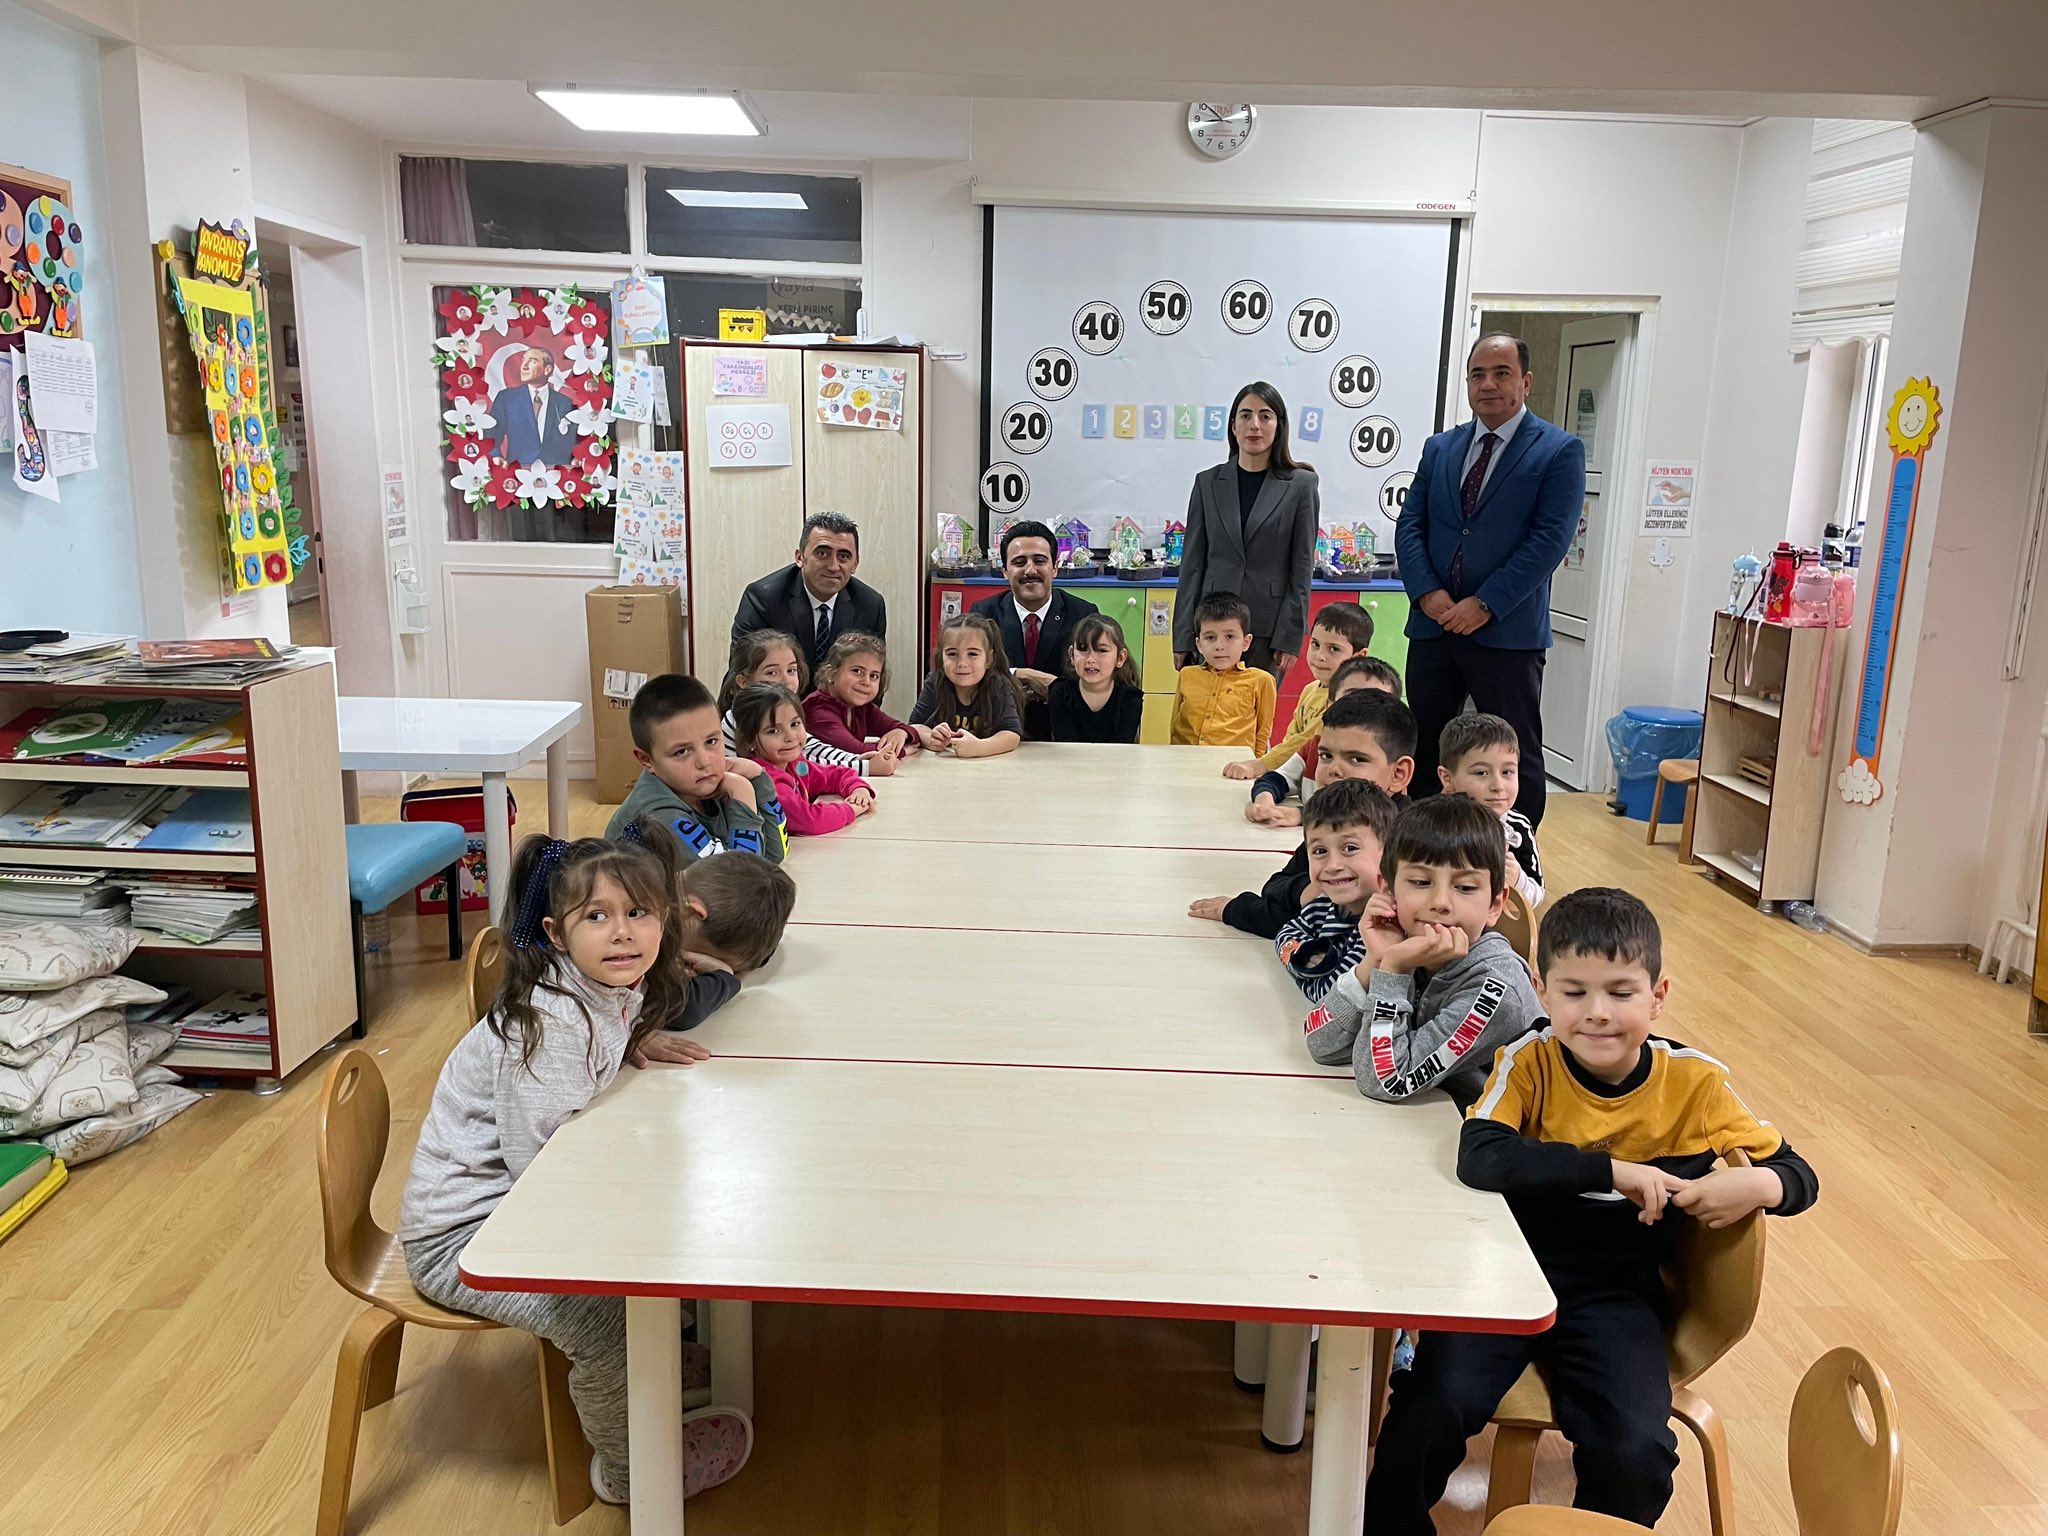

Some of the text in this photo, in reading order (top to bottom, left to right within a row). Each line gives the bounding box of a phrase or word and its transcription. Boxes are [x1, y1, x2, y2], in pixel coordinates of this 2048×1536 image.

[1217, 141, 1224, 149] 6
[196, 251, 243, 282] PANOMUZ
[803, 302, 834, 317] PİRİNÇ
[1147, 292, 1186, 321] 50
[1229, 291, 1267, 320] 60
[1079, 313, 1120, 341] 40
[1298, 310, 1333, 338] 70
[1034, 358, 1072, 387] 30
[1338, 366, 1375, 394] 80
[1009, 412, 1047, 440] 20
[1088, 409, 1099, 429] 1
[1120, 409, 1132, 429] 2
[1151, 409, 1162, 429] 3
[1178, 409, 1192, 430] 4
[1210, 410, 1223, 431] 5
[1305, 411, 1317, 432] 8
[1357, 426, 1395, 453] 90
[986, 474, 1023, 502] 10
[1484, 978, 1506, 997] IS
[1473, 993, 1499, 1017] NO
[1447, 1013, 1487, 1056] LIMITS
[1406, 1053, 1447, 1091] THERE
